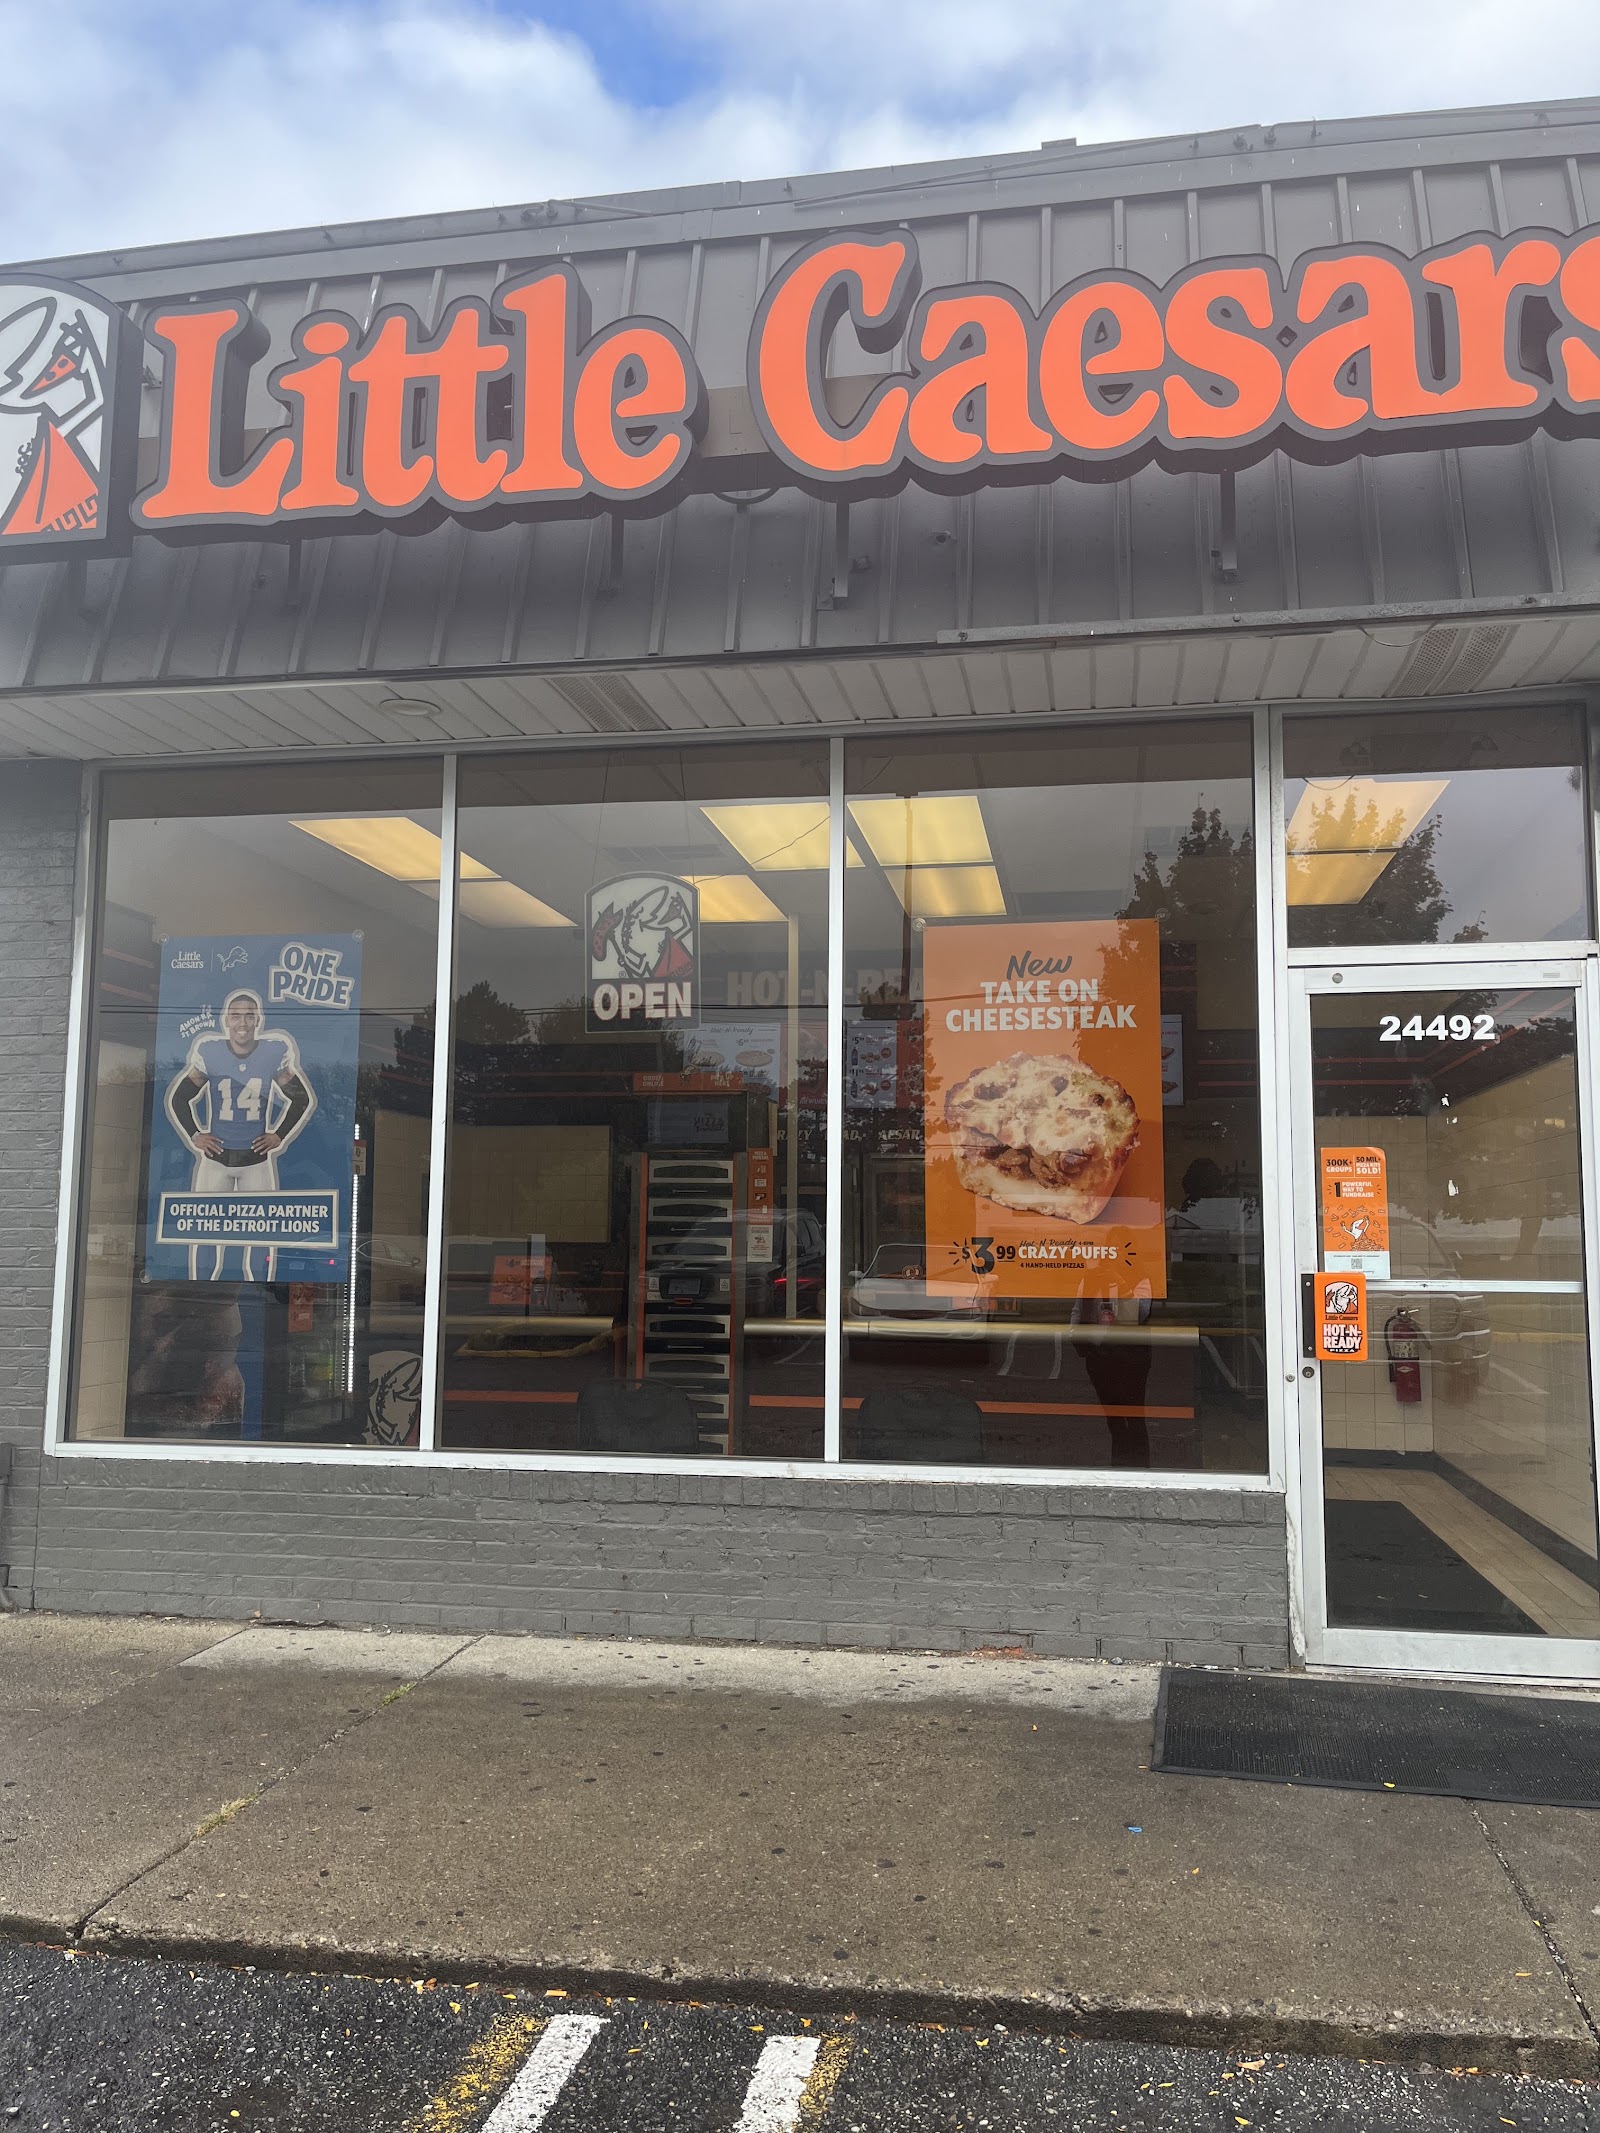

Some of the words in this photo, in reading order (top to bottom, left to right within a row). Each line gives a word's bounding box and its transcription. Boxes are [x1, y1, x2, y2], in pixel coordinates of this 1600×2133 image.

[142, 273, 688, 517] Little
[170, 959, 204, 969] Caesars
[178, 951, 201, 961] Little
[283, 946, 337, 977] ONE
[1006, 950, 1073, 981] New
[273, 971, 350, 1005] PRIDE
[980, 979, 1051, 1005] TAKE
[1058, 978, 1099, 1003] ON
[593, 981, 692, 1022] OPEN
[945, 1004, 1138, 1032] CHEESESTEAK
[189, 1019, 216, 1035] BROWN
[1378, 1014, 1497, 1043] 24492
[217, 1077, 263, 1122] 14
[1334, 1182, 1341, 1197] 1
[170, 1203, 226, 1217] OFFICIAL
[228, 1204, 266, 1217] PIZZA
[268, 1205, 329, 1218] PARTNER
[176, 1219, 194, 1232] OF
[196, 1219, 221, 1232] THE
[223, 1219, 279, 1233] DETROIT
[281, 1220, 320, 1233] LIONS
[1019, 1238, 1077, 1249] Hot-N-Ready
[1018, 1246, 1069, 1260] CRAZY
[1071, 1246, 1118, 1260] PUFFS
[1323, 1323, 1362, 1337] HOT-N-
[1323, 1336, 1362, 1350] READY
